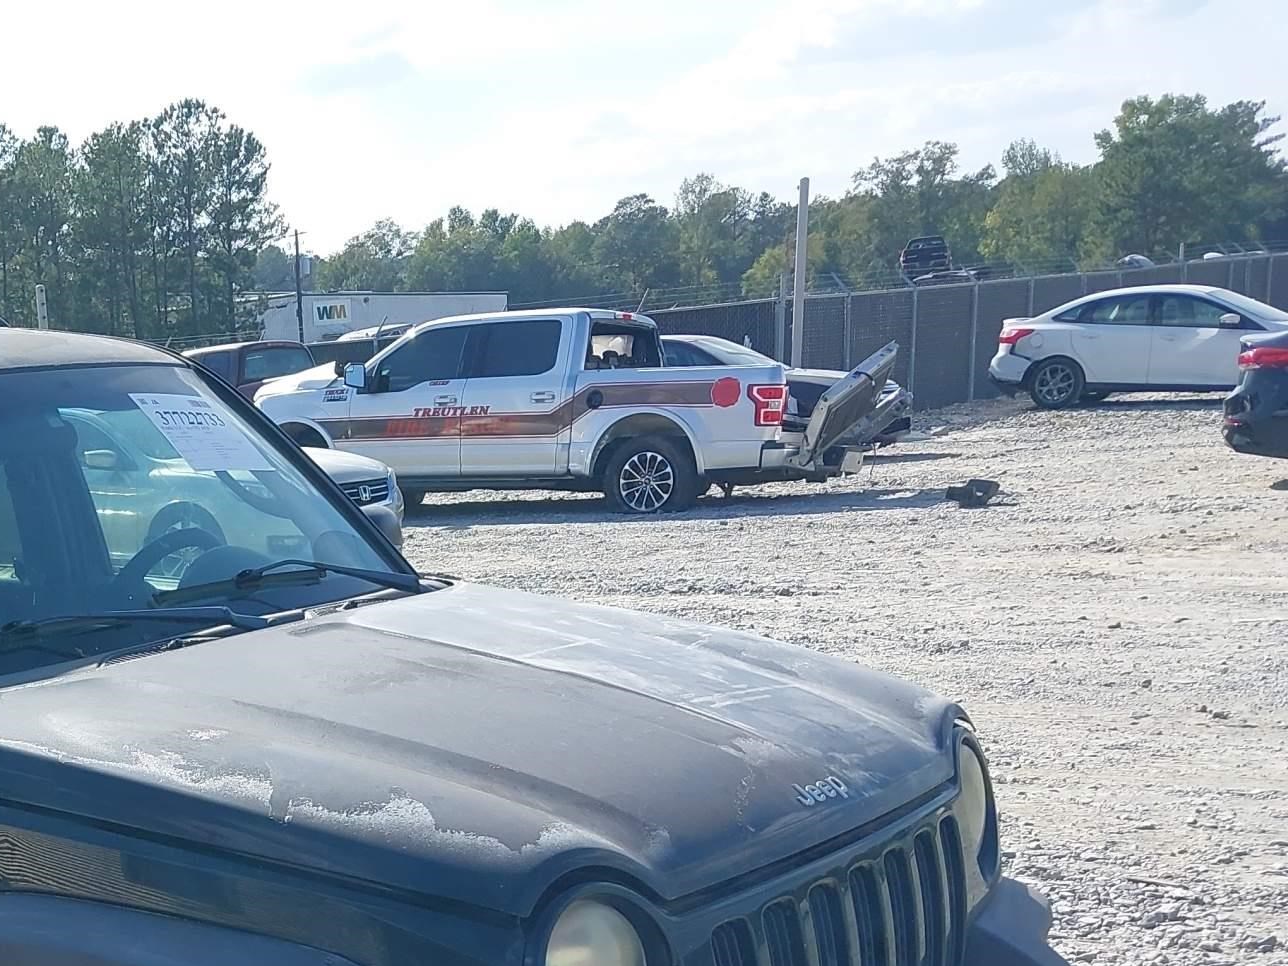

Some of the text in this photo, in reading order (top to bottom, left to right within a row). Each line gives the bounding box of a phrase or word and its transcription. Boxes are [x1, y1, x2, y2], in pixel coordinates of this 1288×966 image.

[317, 305, 347, 320] WM
[155, 410, 226, 426] 37722733
[413, 405, 491, 417] TREUTLEN
[792, 776, 849, 806] Jeep
